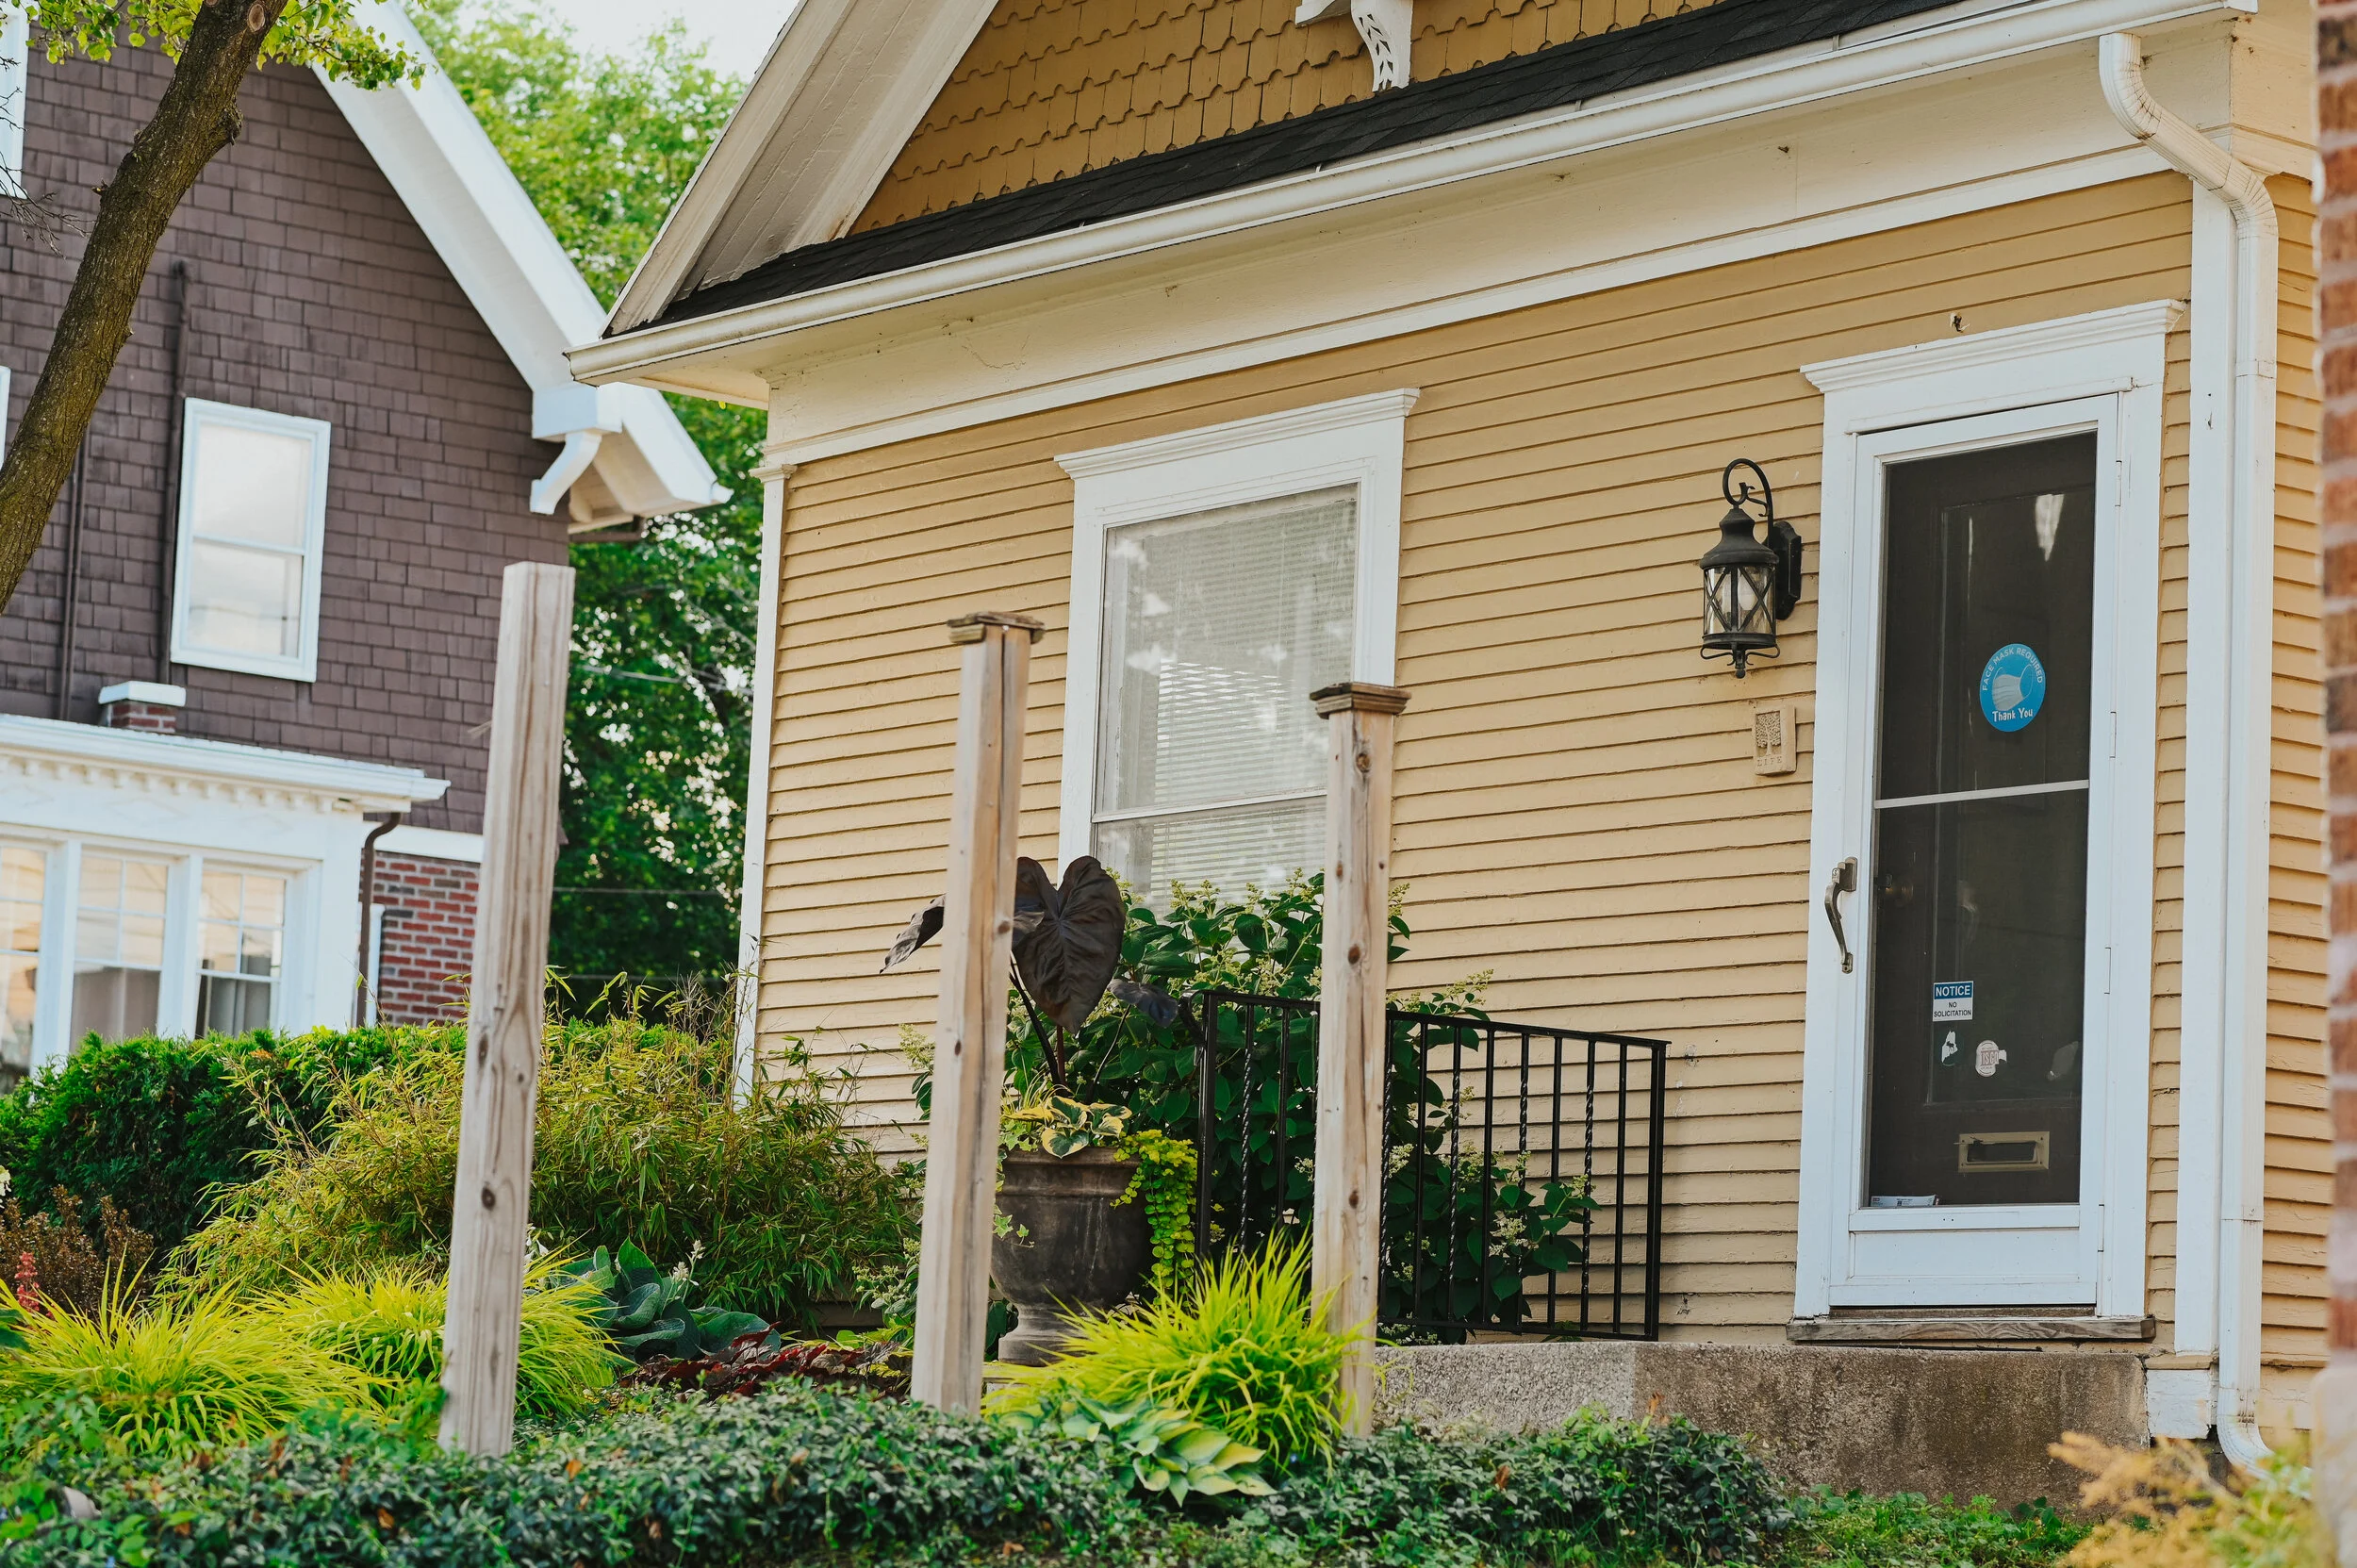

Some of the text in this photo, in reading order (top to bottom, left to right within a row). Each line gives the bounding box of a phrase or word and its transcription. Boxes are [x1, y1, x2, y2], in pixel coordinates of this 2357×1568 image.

[1982, 647, 2043, 690] FACE MASK REQUIRED
[1992, 707, 2033, 722] Thank You
[1936, 985, 1970, 997] NOTICE
[1934, 1009, 1971, 1017] SOLICITATION
